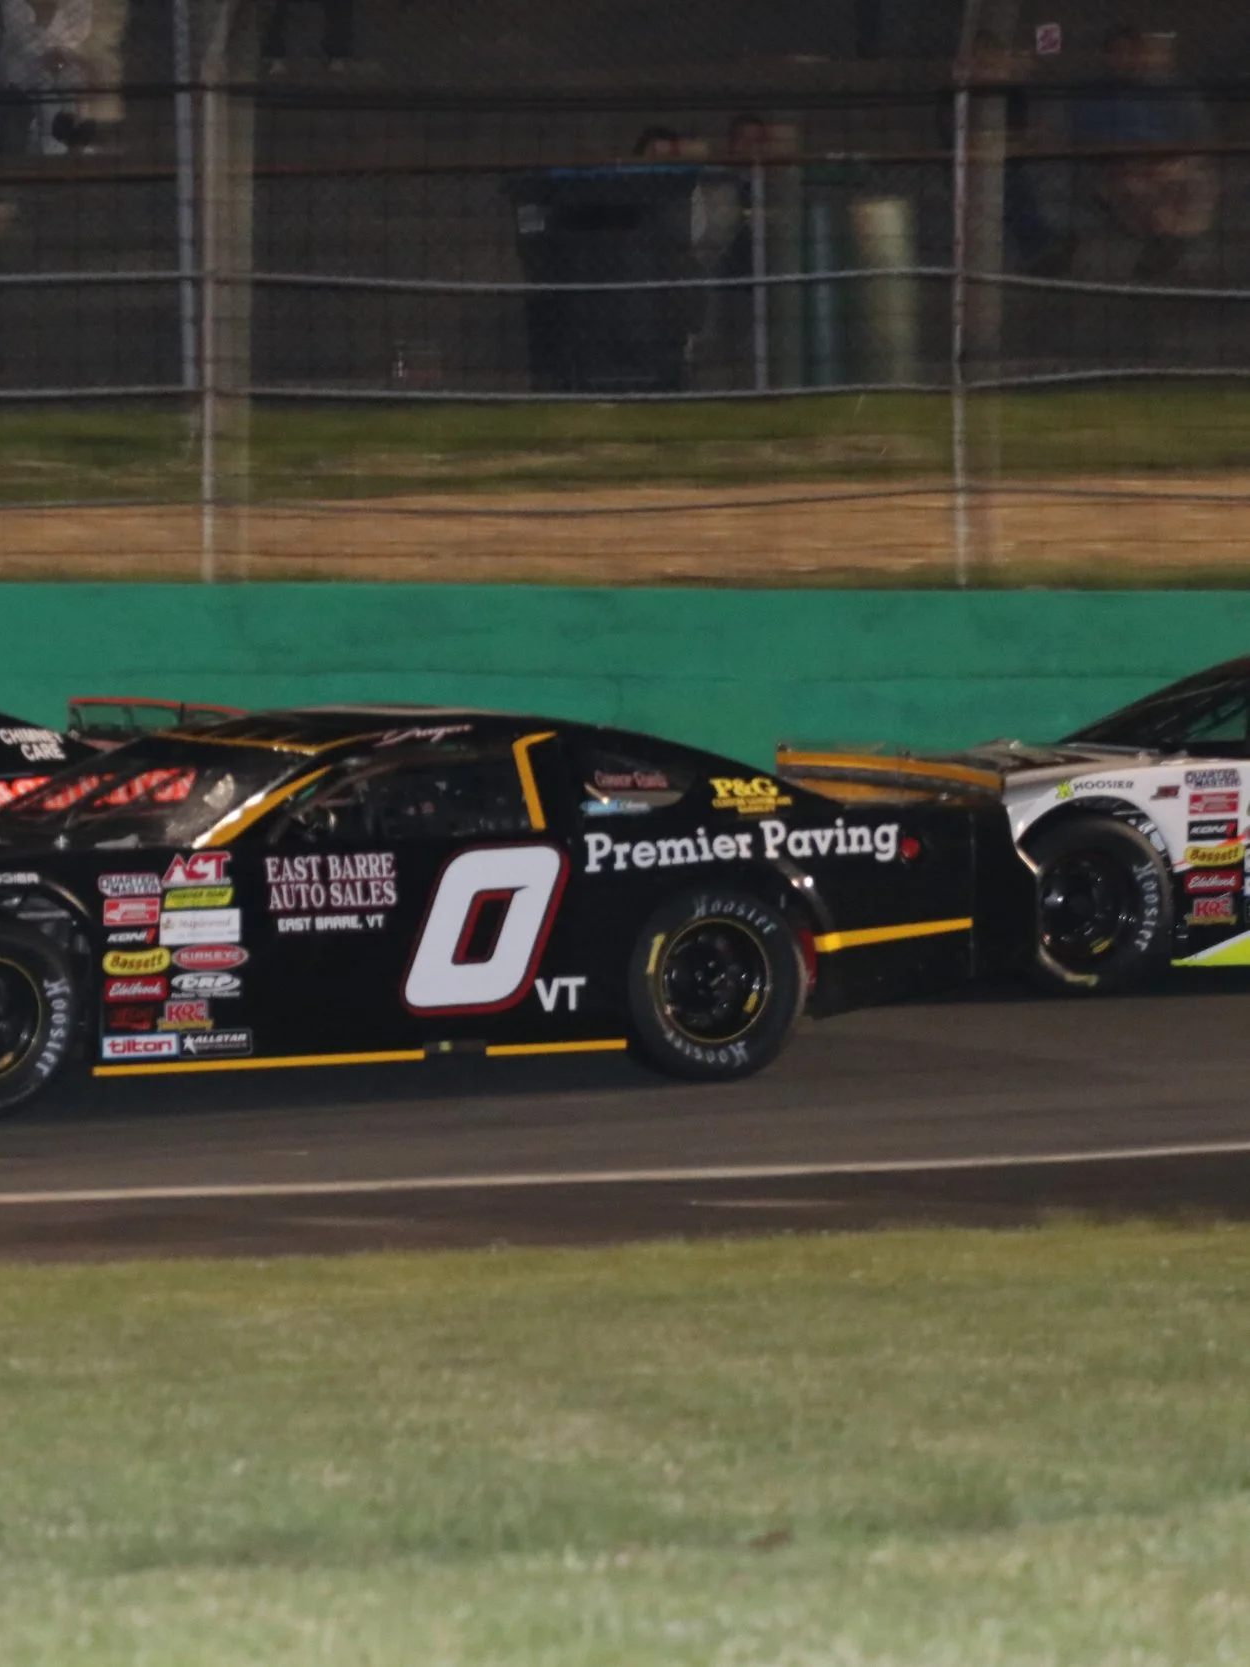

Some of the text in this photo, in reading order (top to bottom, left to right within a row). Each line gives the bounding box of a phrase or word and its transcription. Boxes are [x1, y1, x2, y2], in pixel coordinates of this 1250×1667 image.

[20, 744, 66, 761] CARE
[708, 776, 779, 798] P&G
[1073, 780, 1135, 792] HOOSIER
[584, 817, 899, 873] Premier Paving
[163, 852, 232, 883] ACT
[265, 852, 397, 884] EAST BARRE
[269, 880, 398, 911] AUTO SALES
[278, 914, 385, 933] EAST BARRE, VT
[402, 845, 567, 1013] 0
[110, 952, 164, 970] Bassett
[534, 976, 587, 1012] VT
[109, 1039, 172, 1054] tilton
[193, 1032, 247, 1043] ALLSTAR
